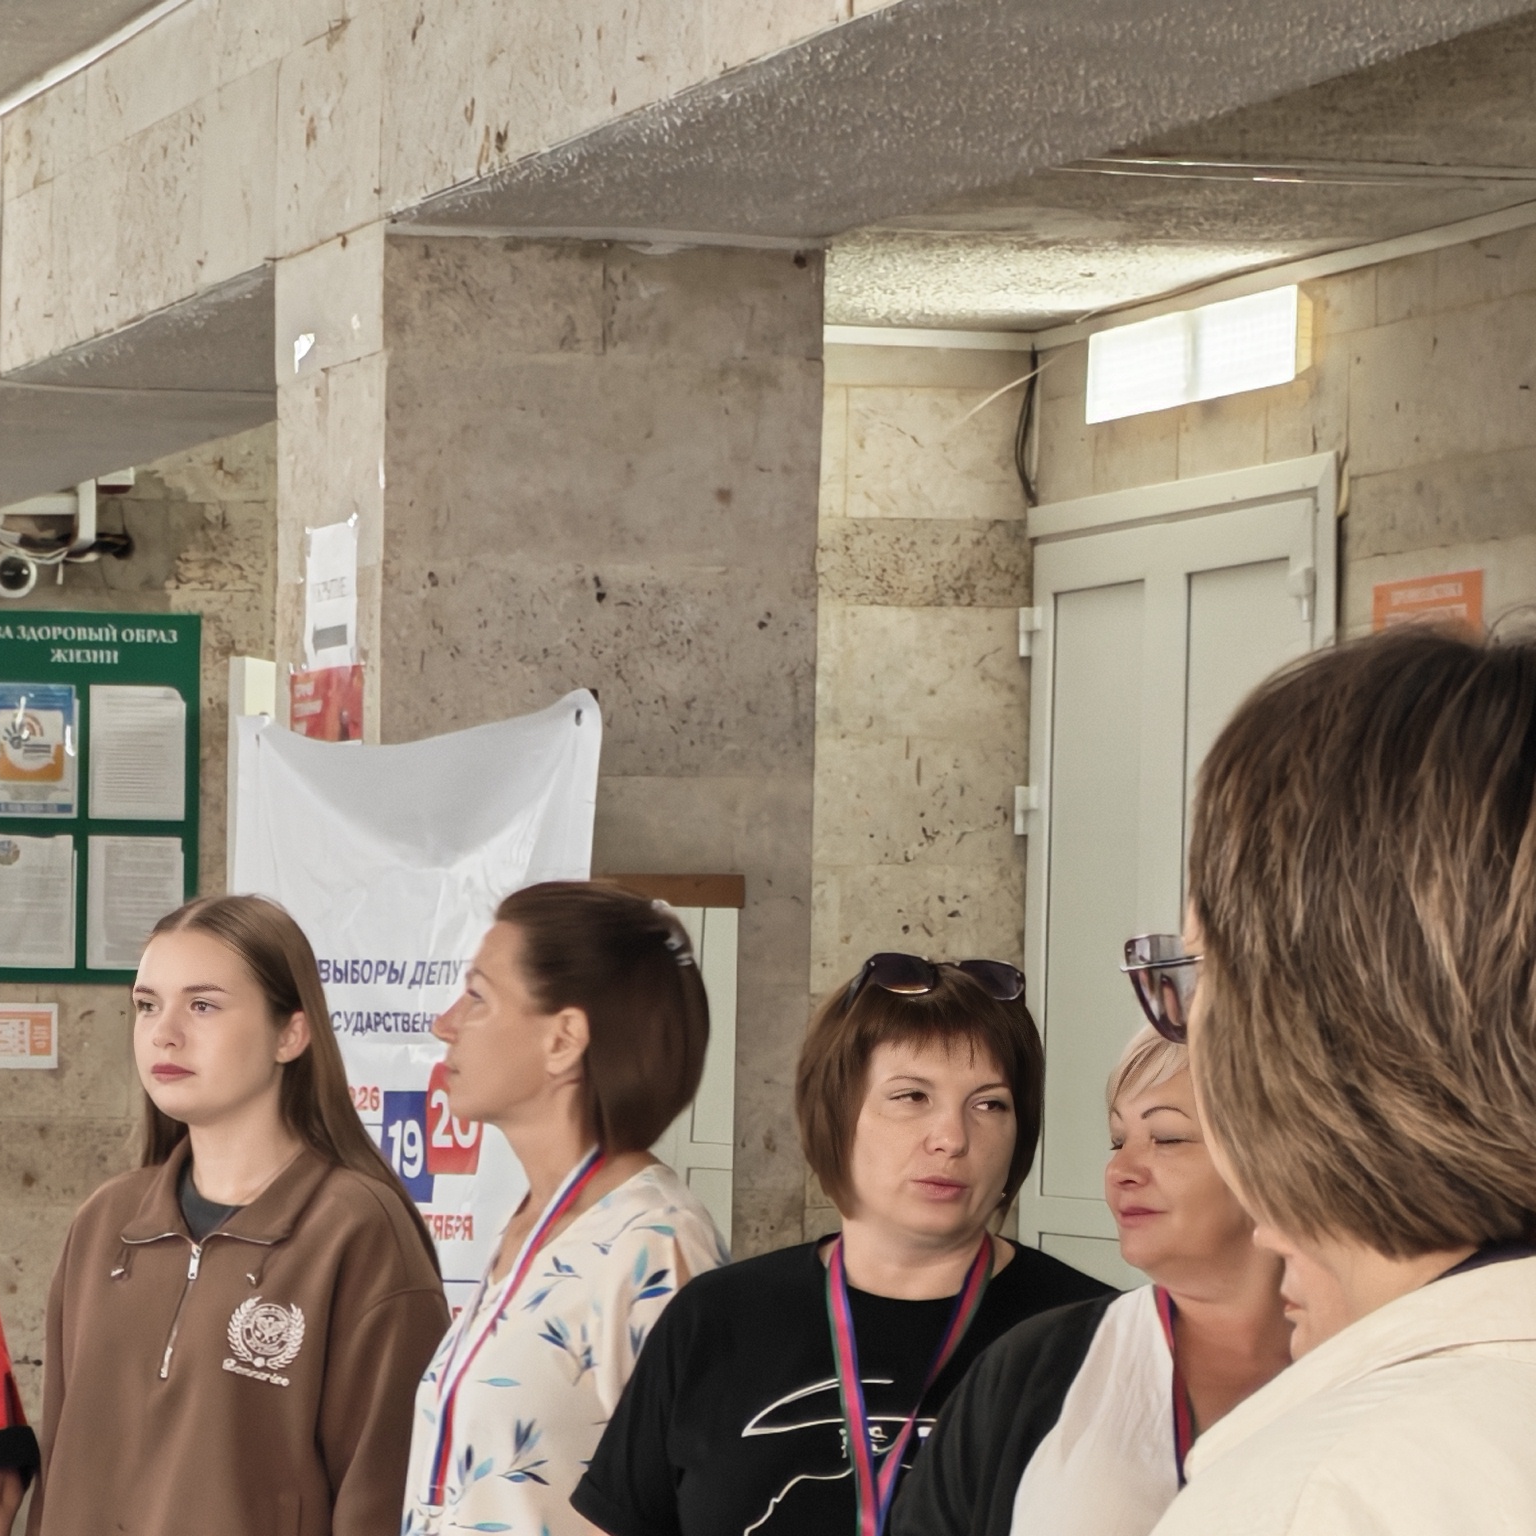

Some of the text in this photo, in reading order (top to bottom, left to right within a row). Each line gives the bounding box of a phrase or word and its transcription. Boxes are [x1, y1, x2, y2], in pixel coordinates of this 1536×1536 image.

[16, 623, 118, 643] ЗДОРОВЫЙ
[121, 628, 179, 644] ОБРАЗ
[49, 648, 119, 665] ЖИЗНИ
[318, 959, 471, 989] ВЫБОРЫ ДЕПУ
[330, 1010, 440, 1036] СУДАРСТВЕН
[387, 1119, 424, 1179] 19
